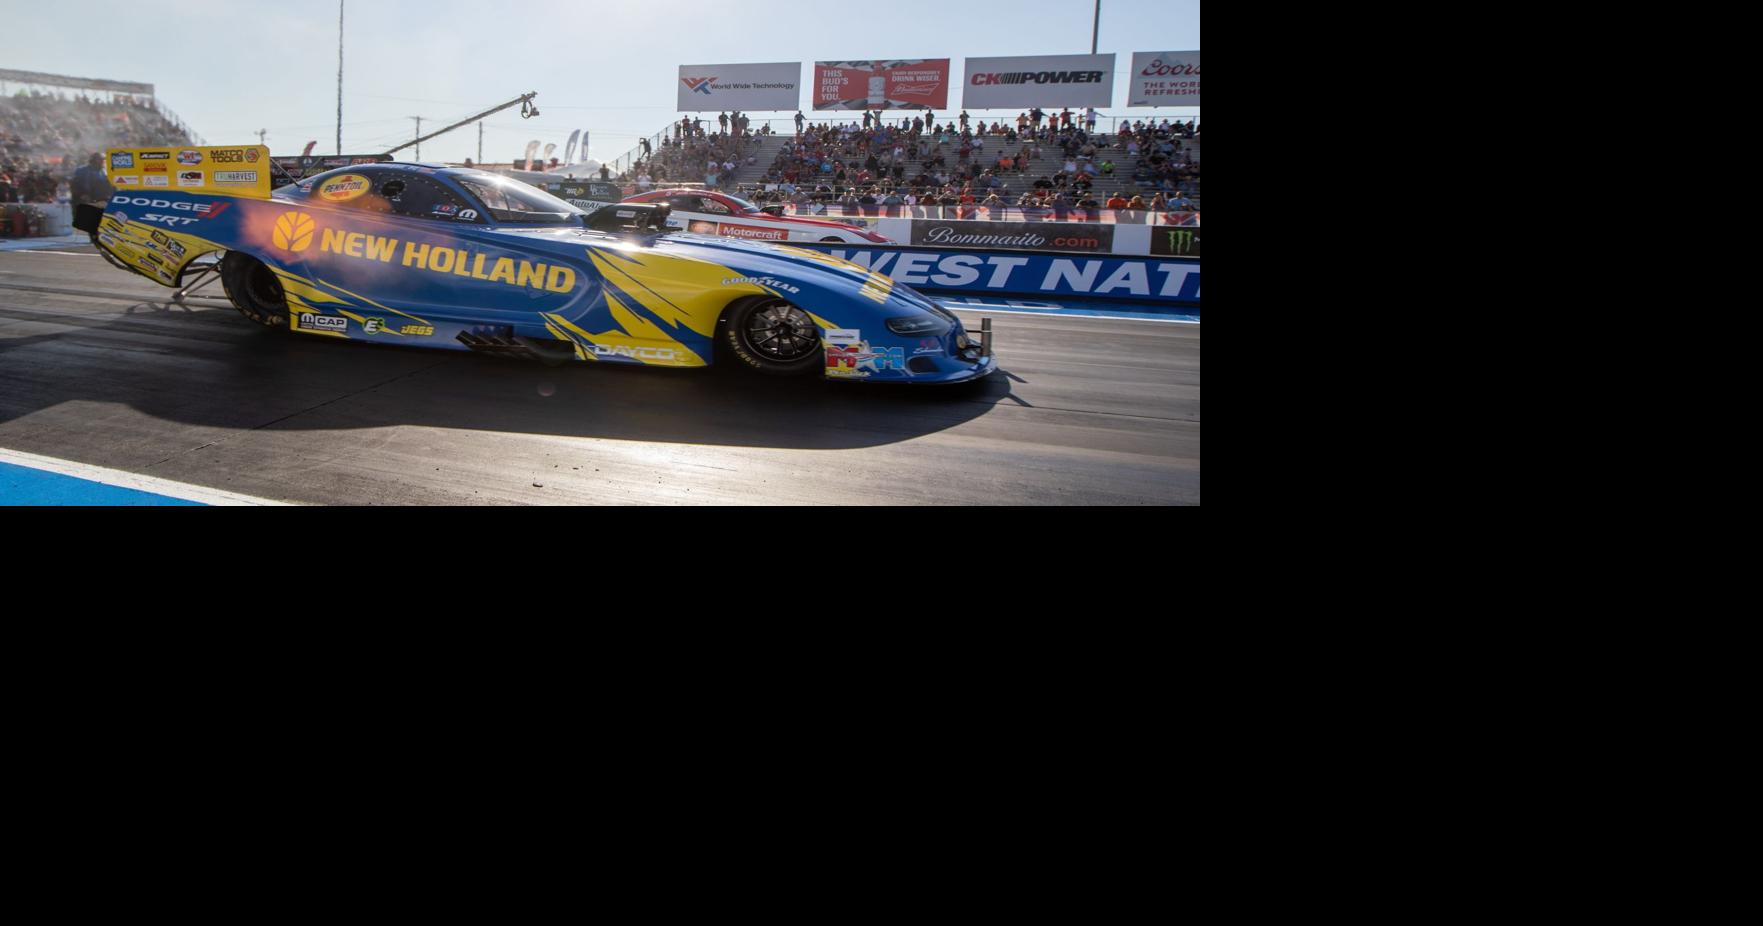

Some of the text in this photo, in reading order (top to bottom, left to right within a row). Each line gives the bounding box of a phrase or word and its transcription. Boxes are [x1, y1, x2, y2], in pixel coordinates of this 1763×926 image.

[822, 77, 849, 85] BUD'S
[1020, 70, 1104, 84] POWER
[751, 82, 795, 91] Technology
[323, 180, 364, 193] PENNZOIL
[111, 196, 212, 213] DODGE
[139, 213, 199, 226] SRT
[723, 226, 783, 241] Motorcraft
[923, 226, 1098, 248] Bommarito .com
[320, 228, 576, 294] NEW HOLLAND
[721, 275, 800, 295] GOODYEAR
[1040, 258, 1200, 299] NAT
[317, 317, 345, 327] CAP
[401, 325, 434, 336] JEGS
[594, 343, 676, 361] DAYCO
